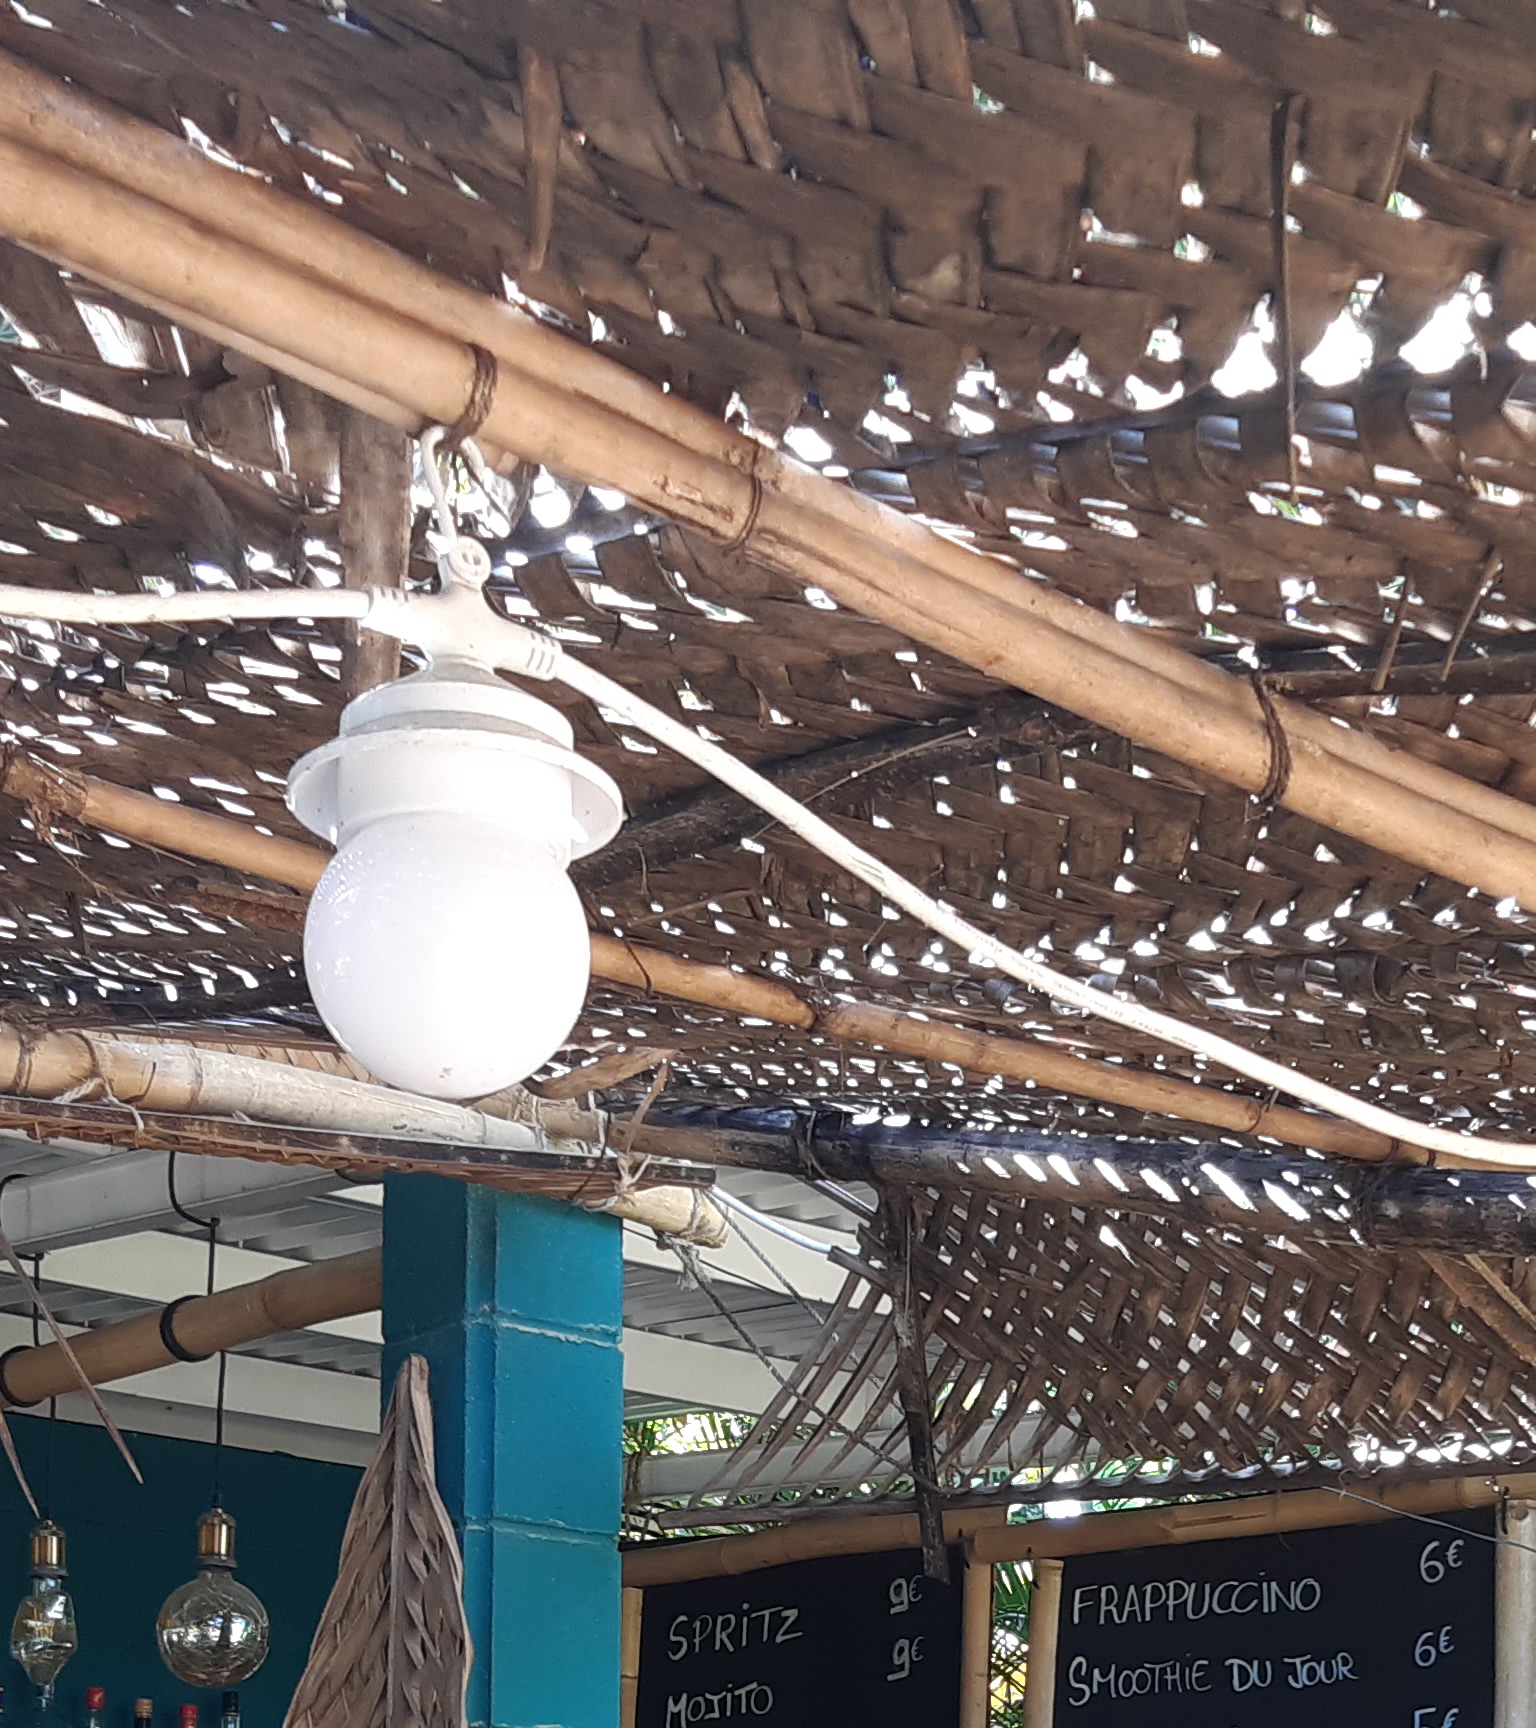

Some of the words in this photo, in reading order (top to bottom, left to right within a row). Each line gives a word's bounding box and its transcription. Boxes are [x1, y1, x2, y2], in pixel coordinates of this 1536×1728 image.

[1419, 1539, 1464, 1583] 6€
[888, 1575, 923, 1616] 9€
[887, 1637, 923, 1681] 9€
[1225, 1657, 1272, 1692] DU
[1283, 1652, 1359, 1690] JOUR
[1414, 1625, 1455, 1668] 6€
